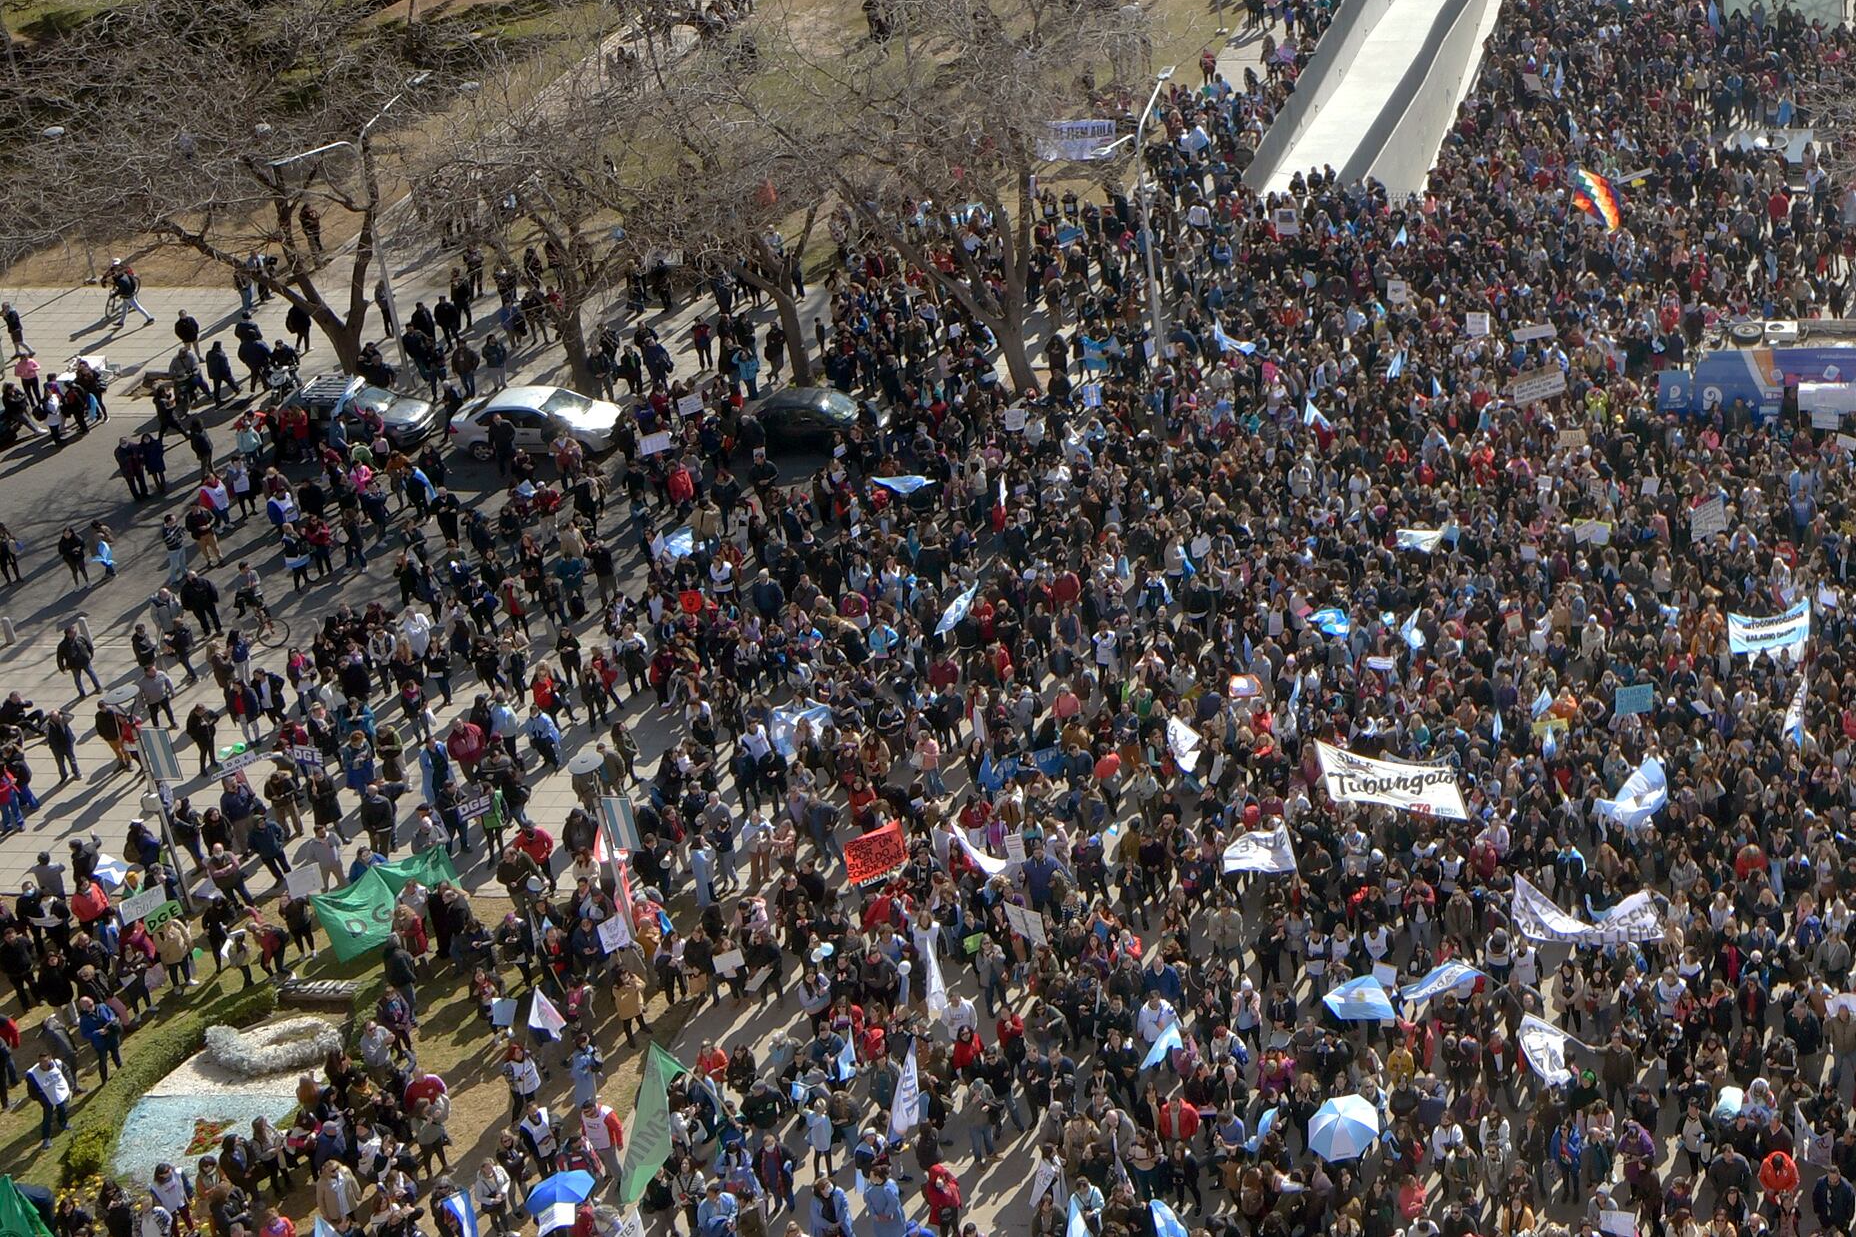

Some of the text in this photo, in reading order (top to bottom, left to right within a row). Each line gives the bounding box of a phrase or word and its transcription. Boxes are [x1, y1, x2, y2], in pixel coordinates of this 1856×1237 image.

[294, 749, 323, 763] DGE
[458, 794, 490, 816] DGE
[848, 848, 890, 871] SUELDO
[147, 904, 179, 931] DGE
[344, 903, 395, 939] DG
